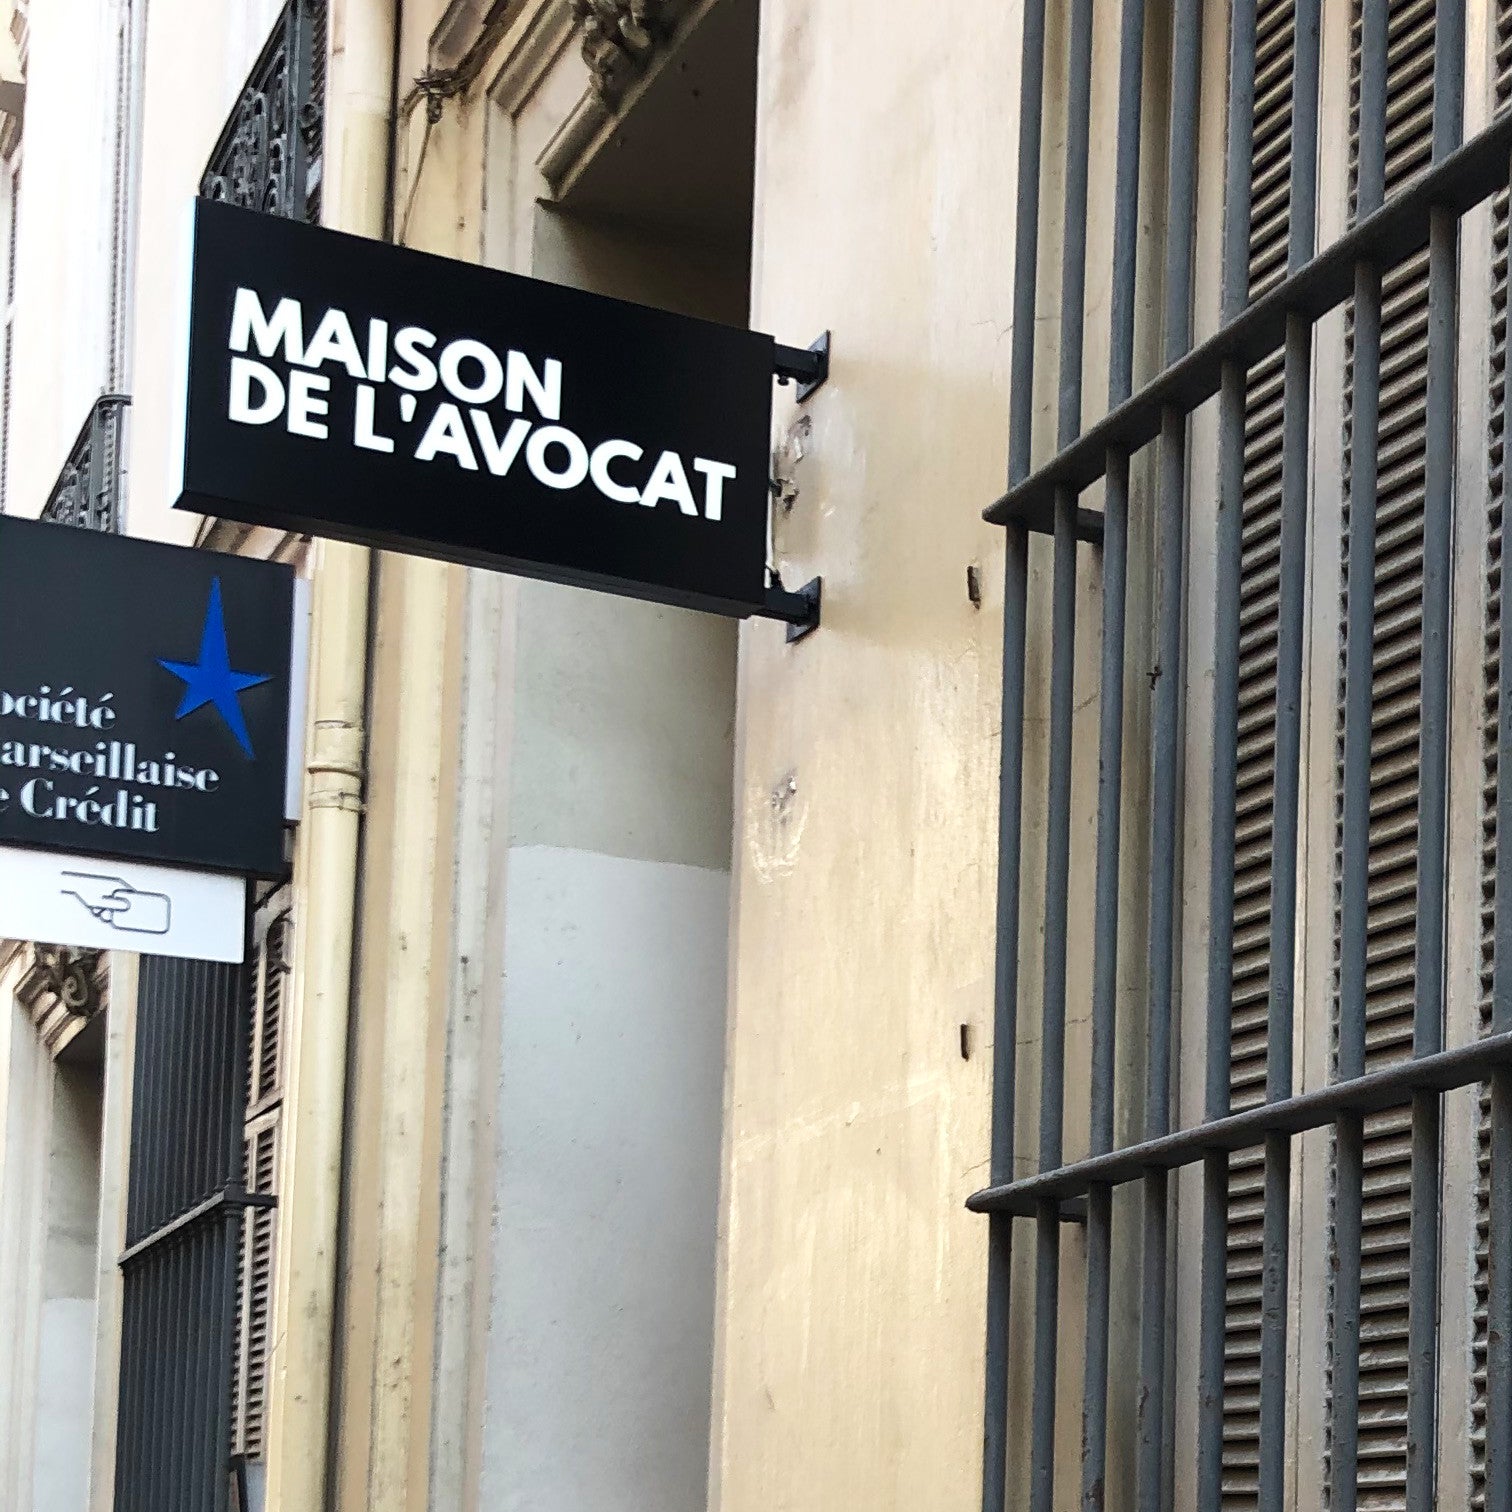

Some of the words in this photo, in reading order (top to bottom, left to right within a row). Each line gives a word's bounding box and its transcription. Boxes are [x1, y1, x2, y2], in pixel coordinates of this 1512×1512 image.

[228, 287, 563, 421] MAISON
[228, 356, 331, 440] DE
[354, 385, 737, 521] L'AVOCAT
[0, 685, 116, 730] ociété
[0, 741, 220, 792] arseillaise
[20, 778, 160, 832] Crédit
